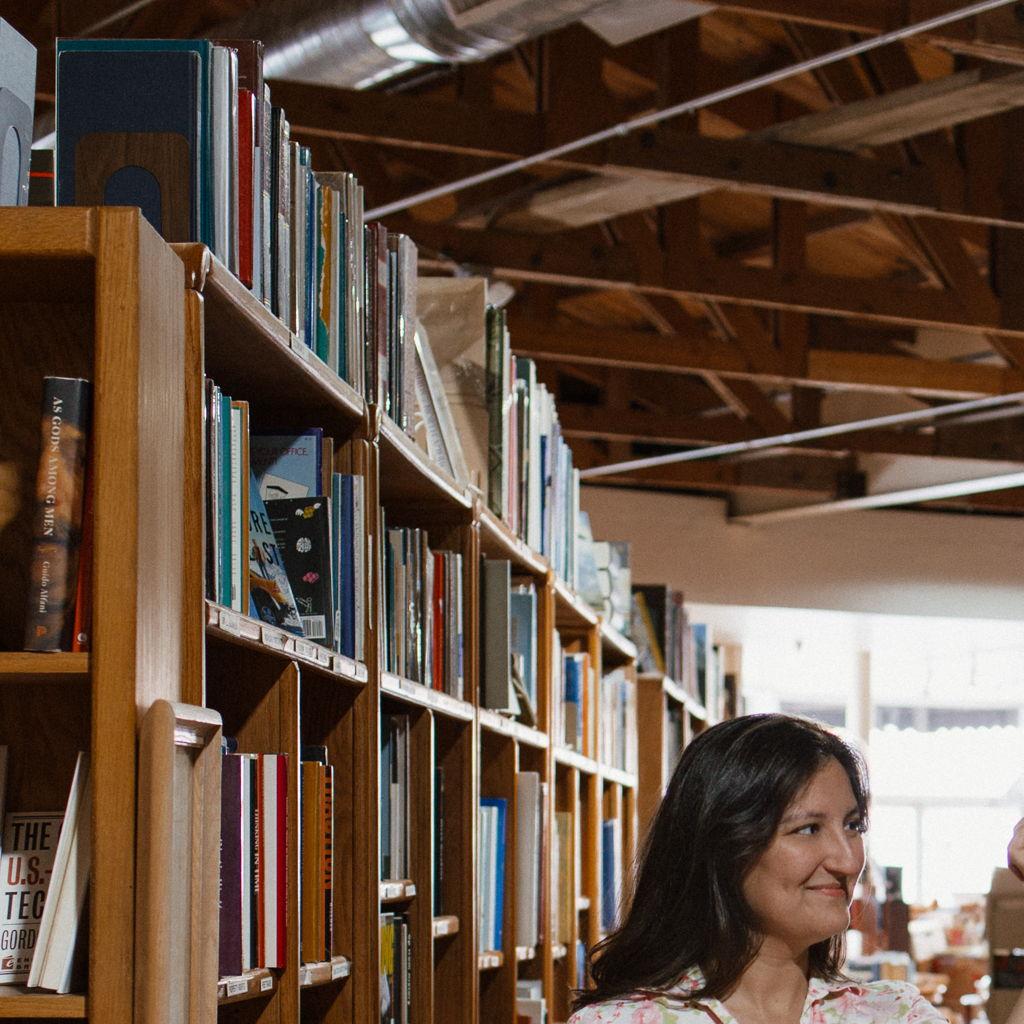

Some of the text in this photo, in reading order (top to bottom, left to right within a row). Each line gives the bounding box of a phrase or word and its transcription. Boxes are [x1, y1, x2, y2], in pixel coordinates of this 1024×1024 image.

[43, 397, 63, 536] AS GODS AMONG MEN
[40, 561, 50, 613] Guido Alfani
[12, 822, 52, 851] THE
